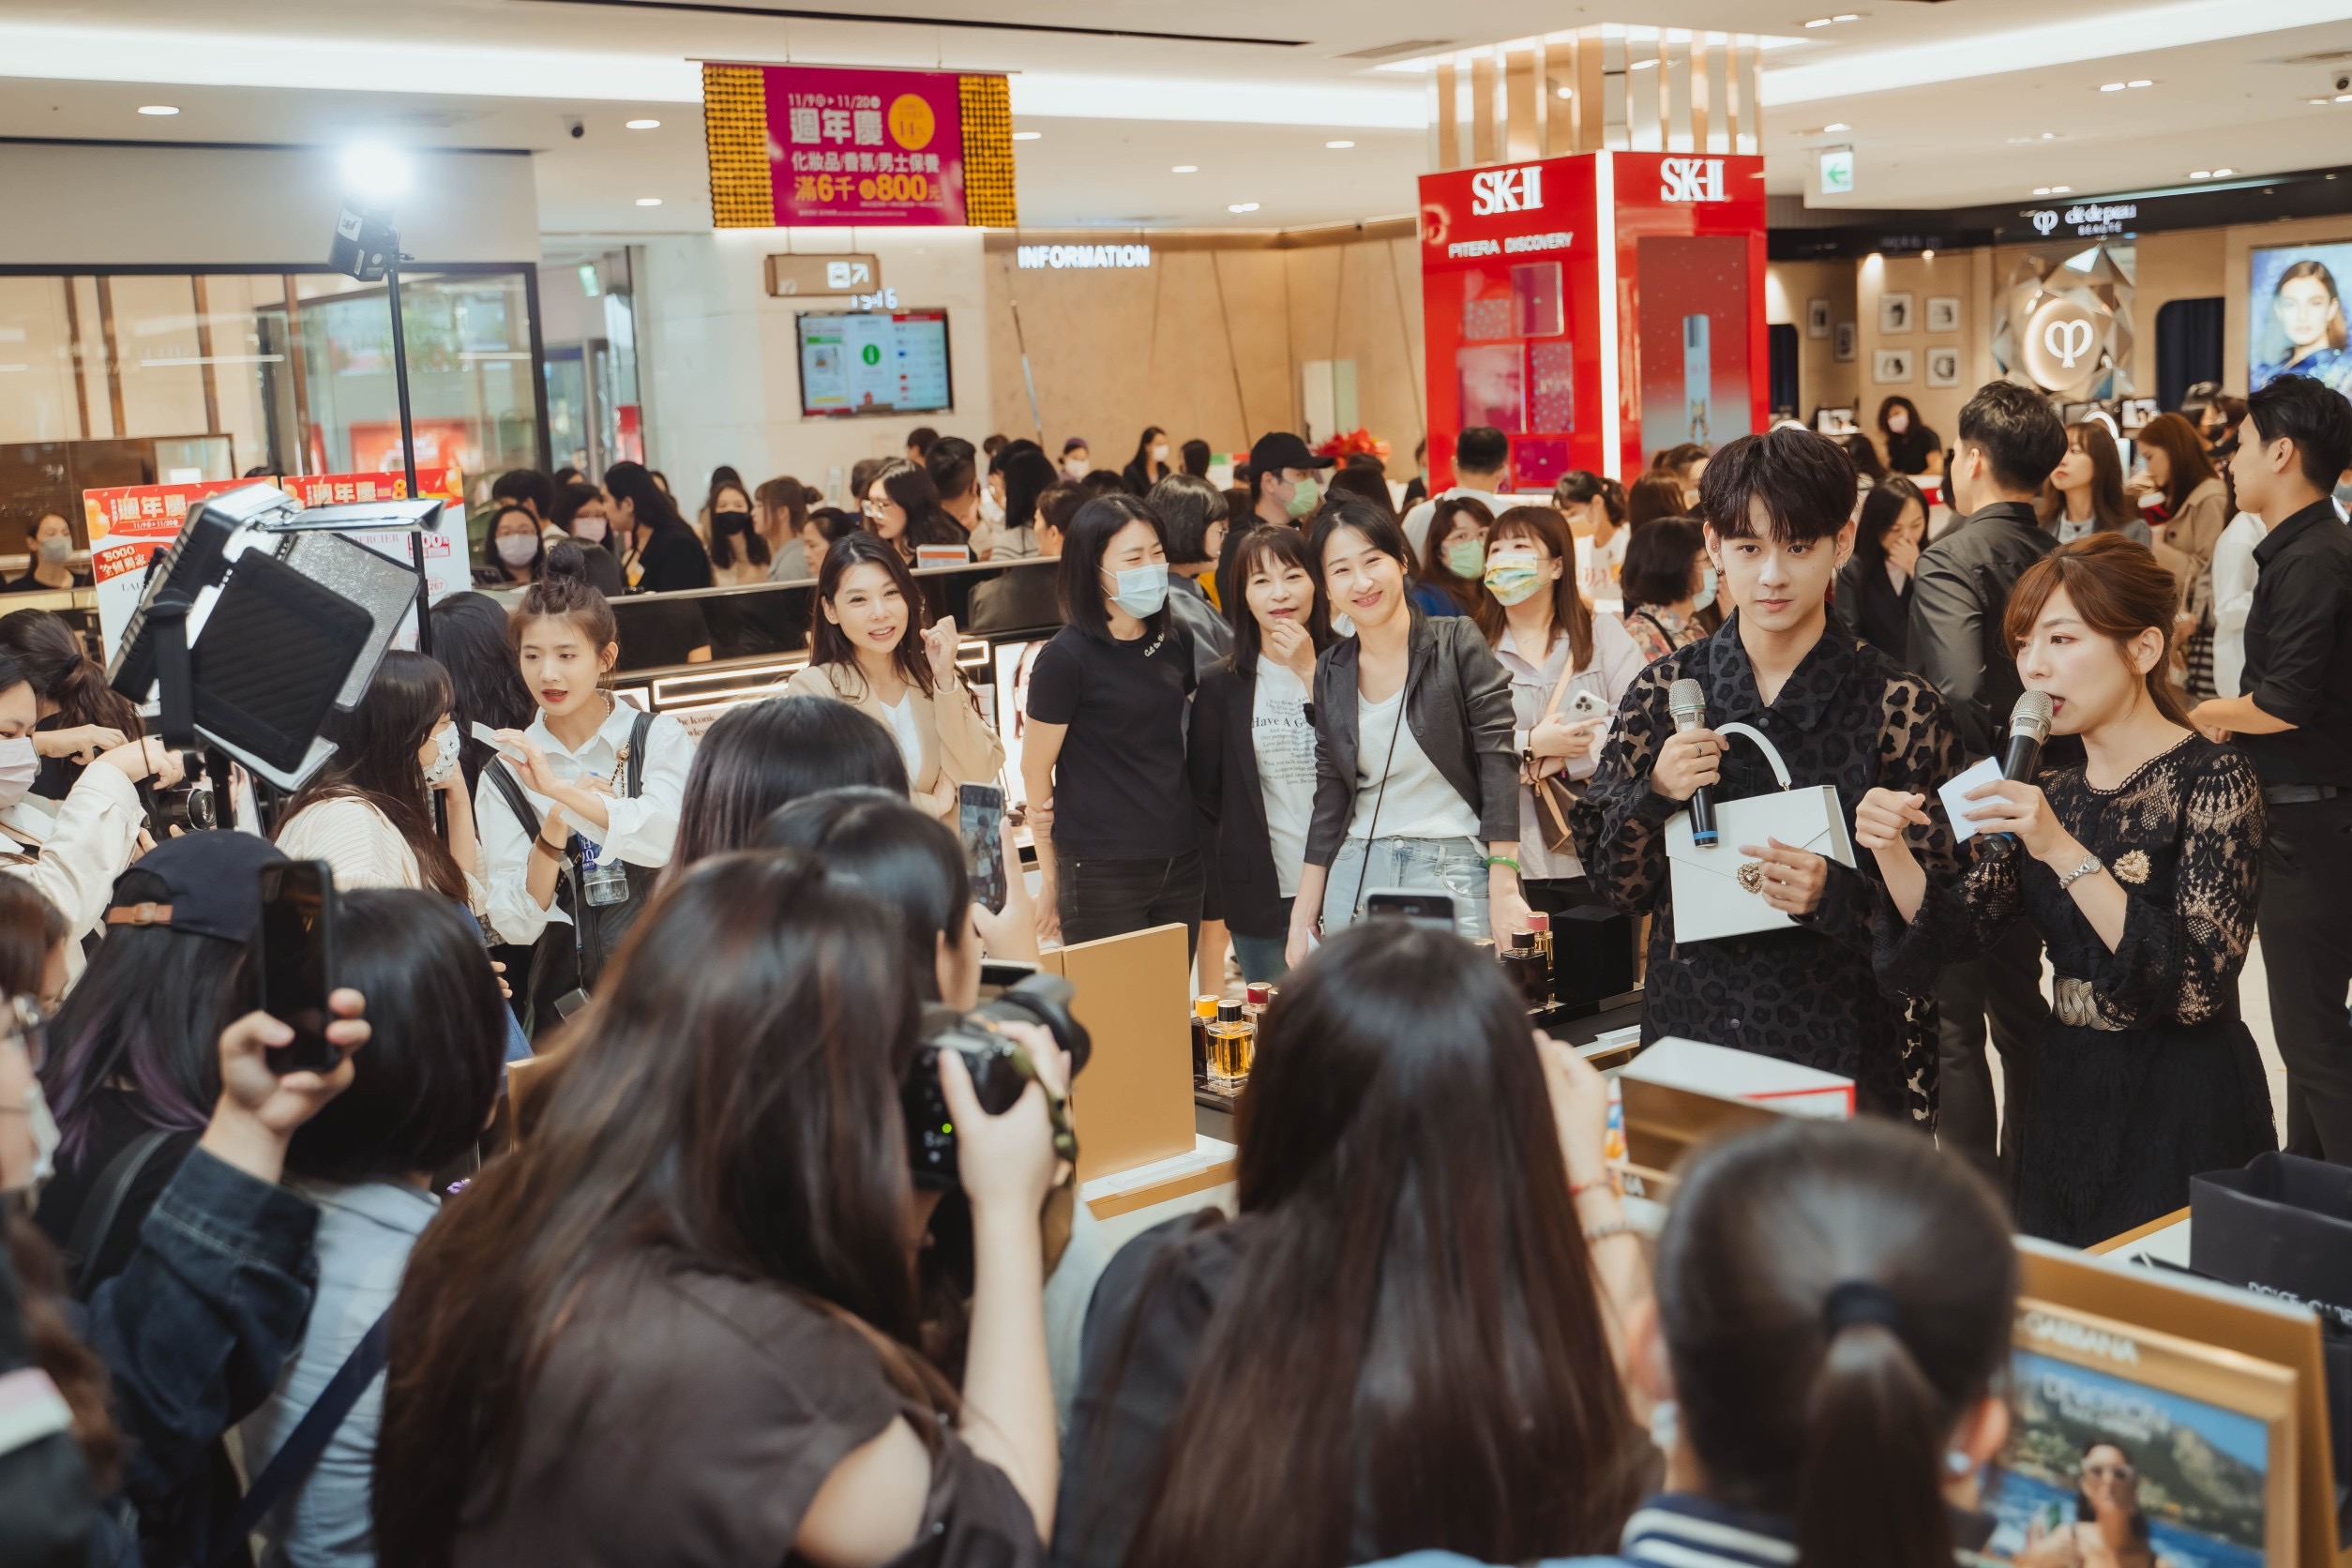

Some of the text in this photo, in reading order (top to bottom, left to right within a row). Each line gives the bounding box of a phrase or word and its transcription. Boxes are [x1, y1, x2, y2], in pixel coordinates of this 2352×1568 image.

[790, 108, 883, 144] 週年慶
[1018, 246, 1151, 268] INFORMATION
[1448, 232, 1575, 258] PITERA DISCOVERY
